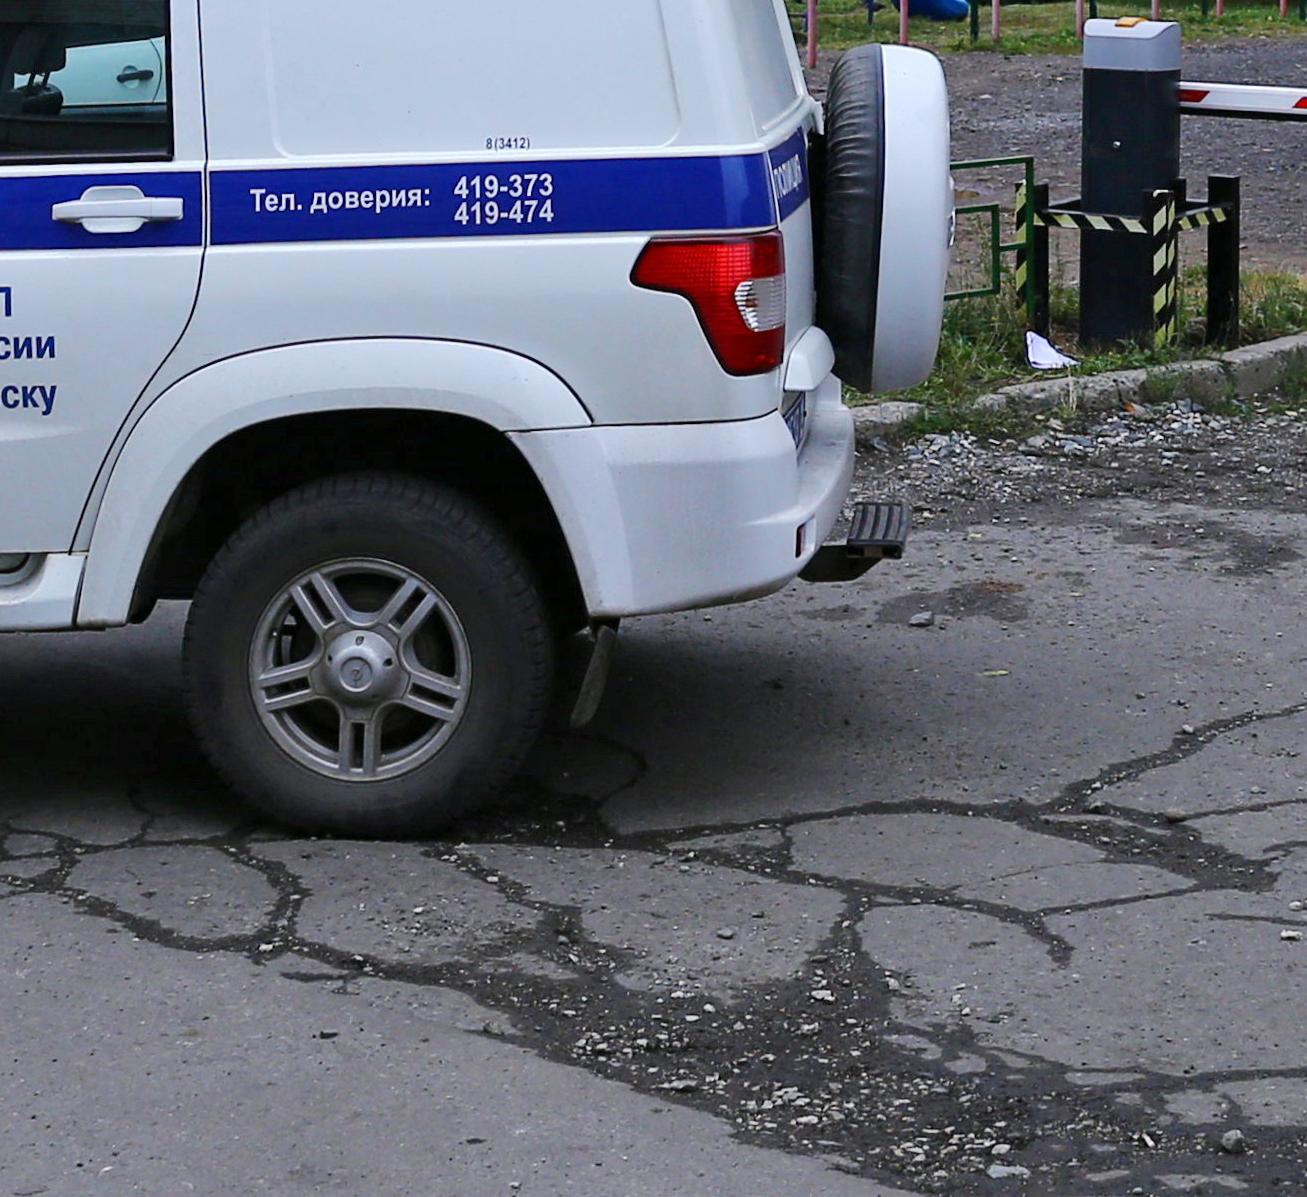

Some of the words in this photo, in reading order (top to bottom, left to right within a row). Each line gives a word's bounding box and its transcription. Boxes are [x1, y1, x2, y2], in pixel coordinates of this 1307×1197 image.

[485, 135, 531, 152] 8(3412)
[249, 188, 303, 213] Тел.
[309, 188, 430, 214] доверия:
[453, 173, 554, 199] 419-373
[453, 199, 555, 225] 419-474
